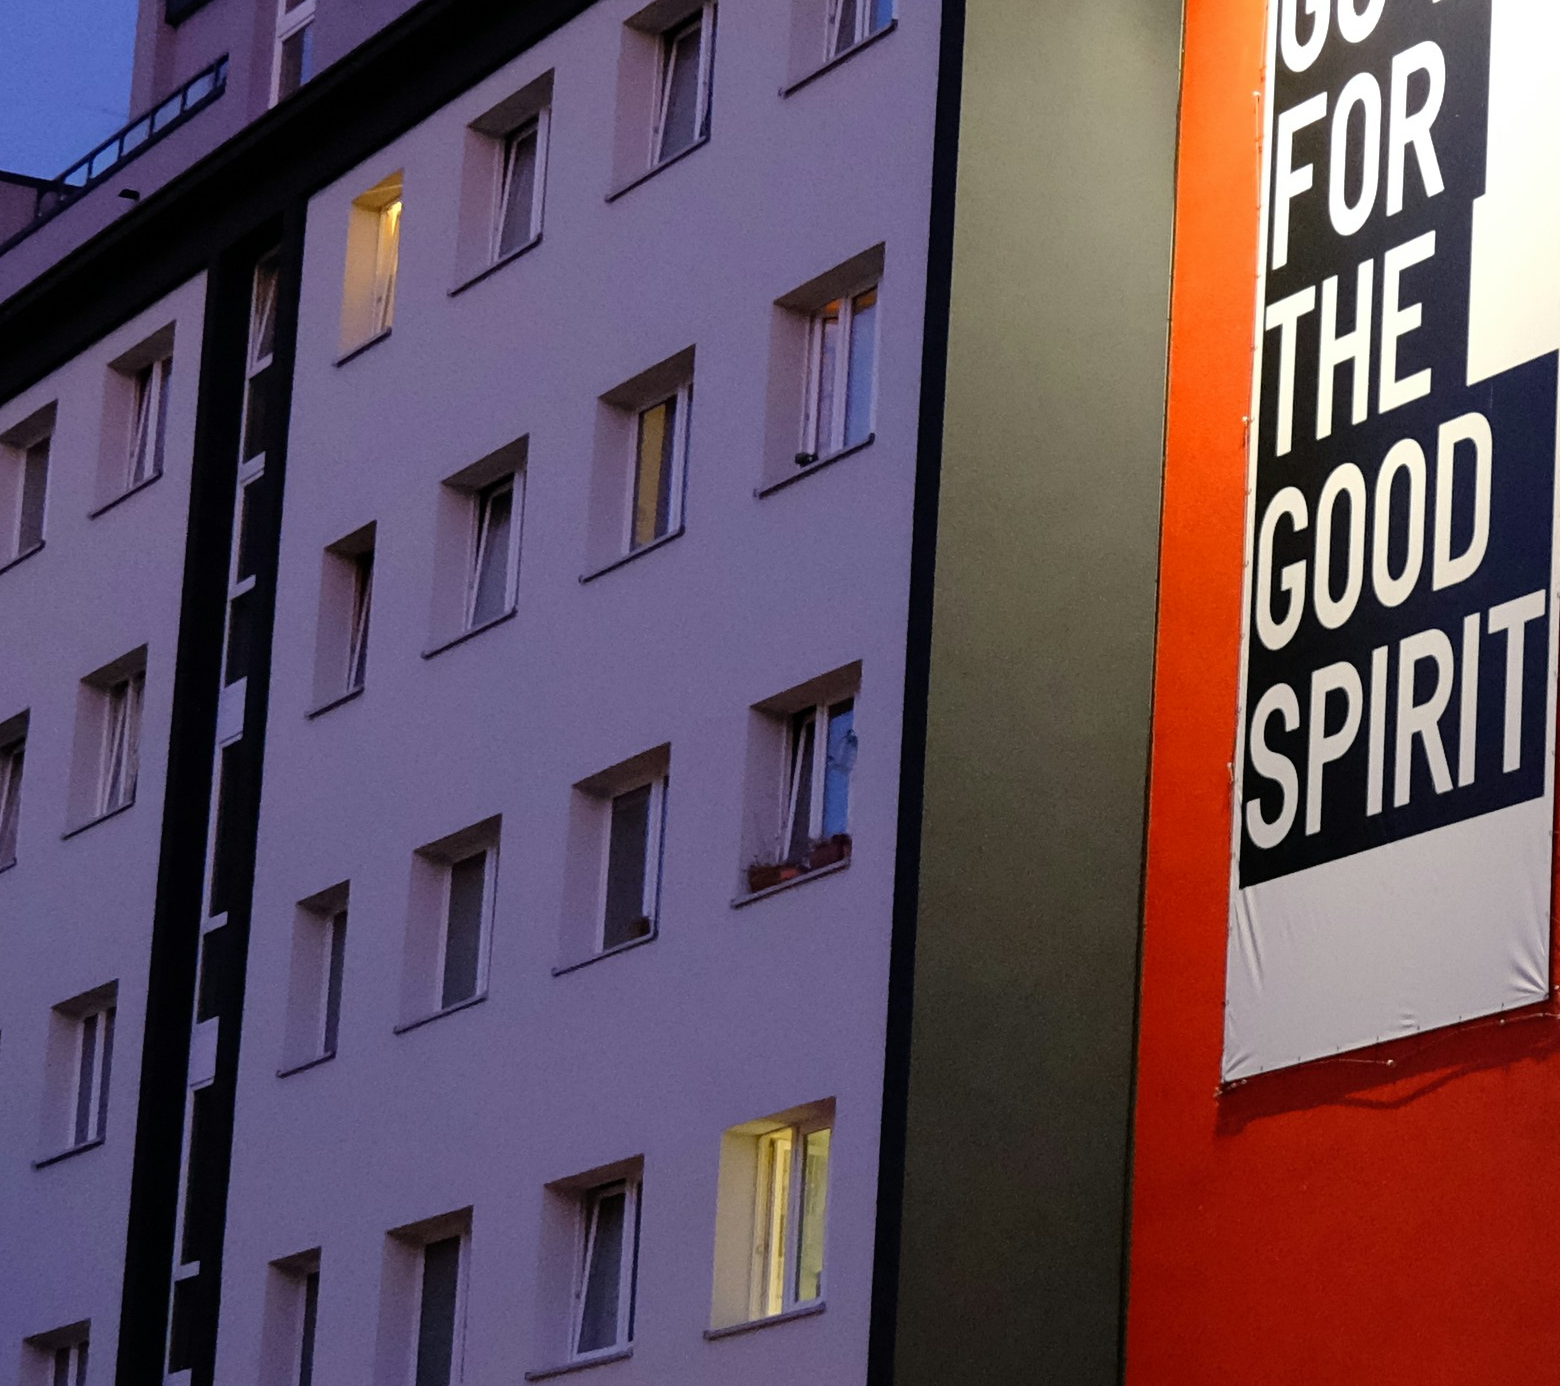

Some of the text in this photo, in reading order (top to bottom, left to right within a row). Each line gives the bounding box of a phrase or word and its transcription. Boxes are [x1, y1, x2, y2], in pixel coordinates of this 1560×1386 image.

[1270, 38, 1447, 270] FOR
[1264, 230, 1437, 458] THE
[1254, 410, 1493, 653] GOOD
[1245, 589, 1547, 852] SPIRIT
